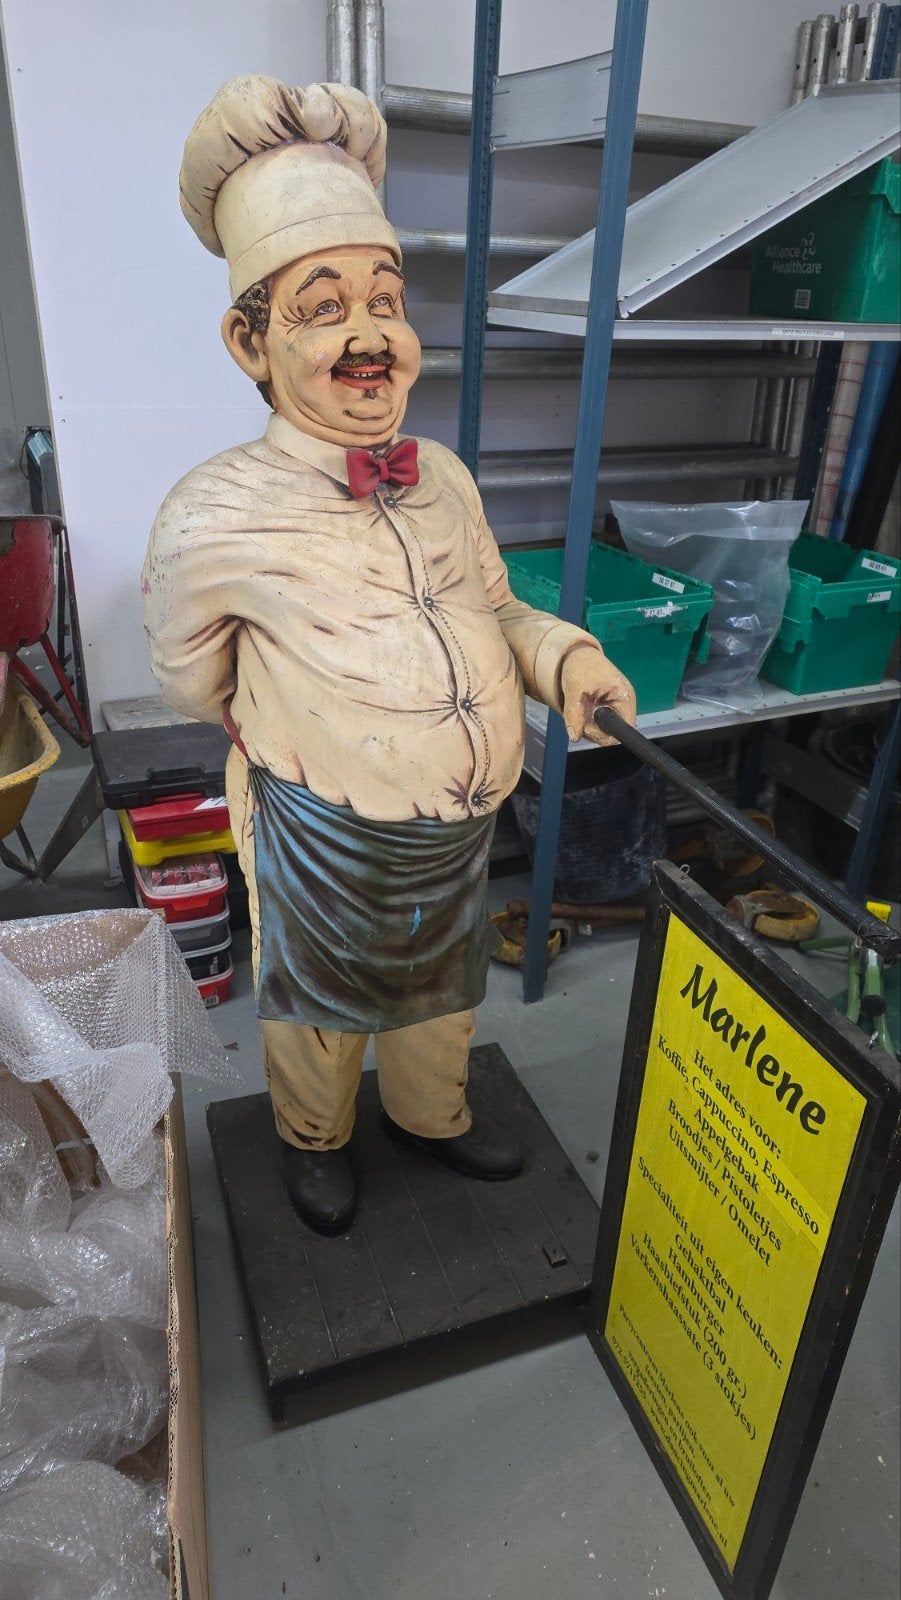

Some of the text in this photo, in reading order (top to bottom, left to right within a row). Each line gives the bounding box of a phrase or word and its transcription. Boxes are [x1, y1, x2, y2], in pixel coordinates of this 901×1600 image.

[765, 243, 801, 258] Alliance
[772, 260, 822, 274] Healthcare
[679, 963, 826, 1136] Marlene
[693, 1049, 781, 1160] Het adres voor:
[657, 1034, 819, 1235] Koffie, Cappuccino, Espresso
[667, 1098, 713, 1163] Broodjes
[721, 1166, 782, 1251] Pistoletjes
[669, 1124, 720, 1198] Uitsmijter
[728, 1203, 771, 1267] Omelet
[693, 1107, 760, 1194] Appelgebak
[638, 1156, 783, 1370] Specialiteit uit eigen keuken:
[642, 1232, 747, 1399] Haasbiefstuk (200 gr.)
[668, 1246, 725, 1337] Hamburger
[675, 1233, 726, 1314] Gehaktbal
[631, 1232, 756, 1441] Varkenshaassate (3 stokjes)
